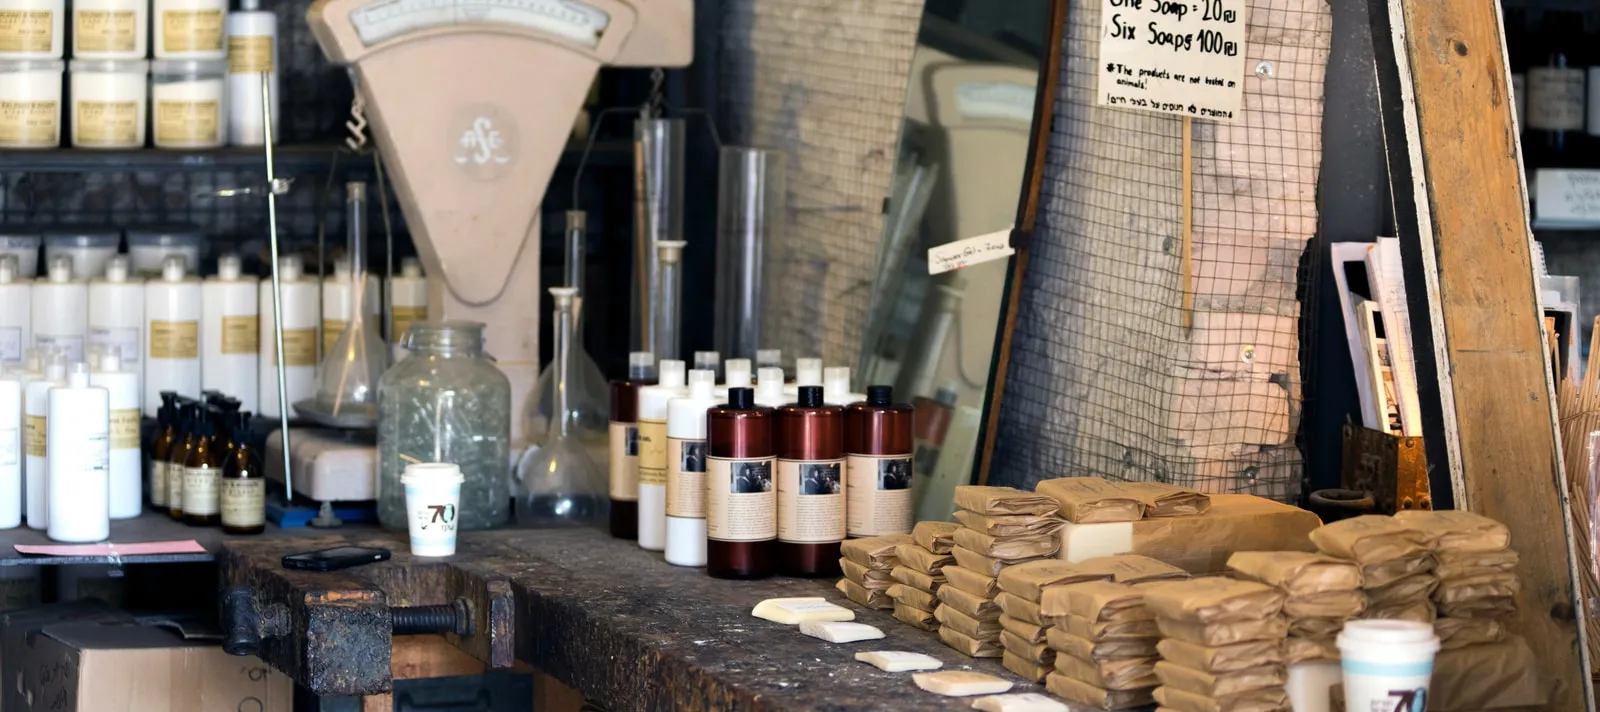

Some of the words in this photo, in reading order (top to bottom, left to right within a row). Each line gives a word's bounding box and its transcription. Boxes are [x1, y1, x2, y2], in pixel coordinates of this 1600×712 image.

[1111, 13, 1136, 40] Six
[1139, 67, 1170, 79] products
[1174, 73, 1185, 82] are
[1189, 75, 1200, 84] not
[1227, 80, 1236, 88] on
[427, 503, 456, 523] 70
[1388, 687, 1428, 712] 70
